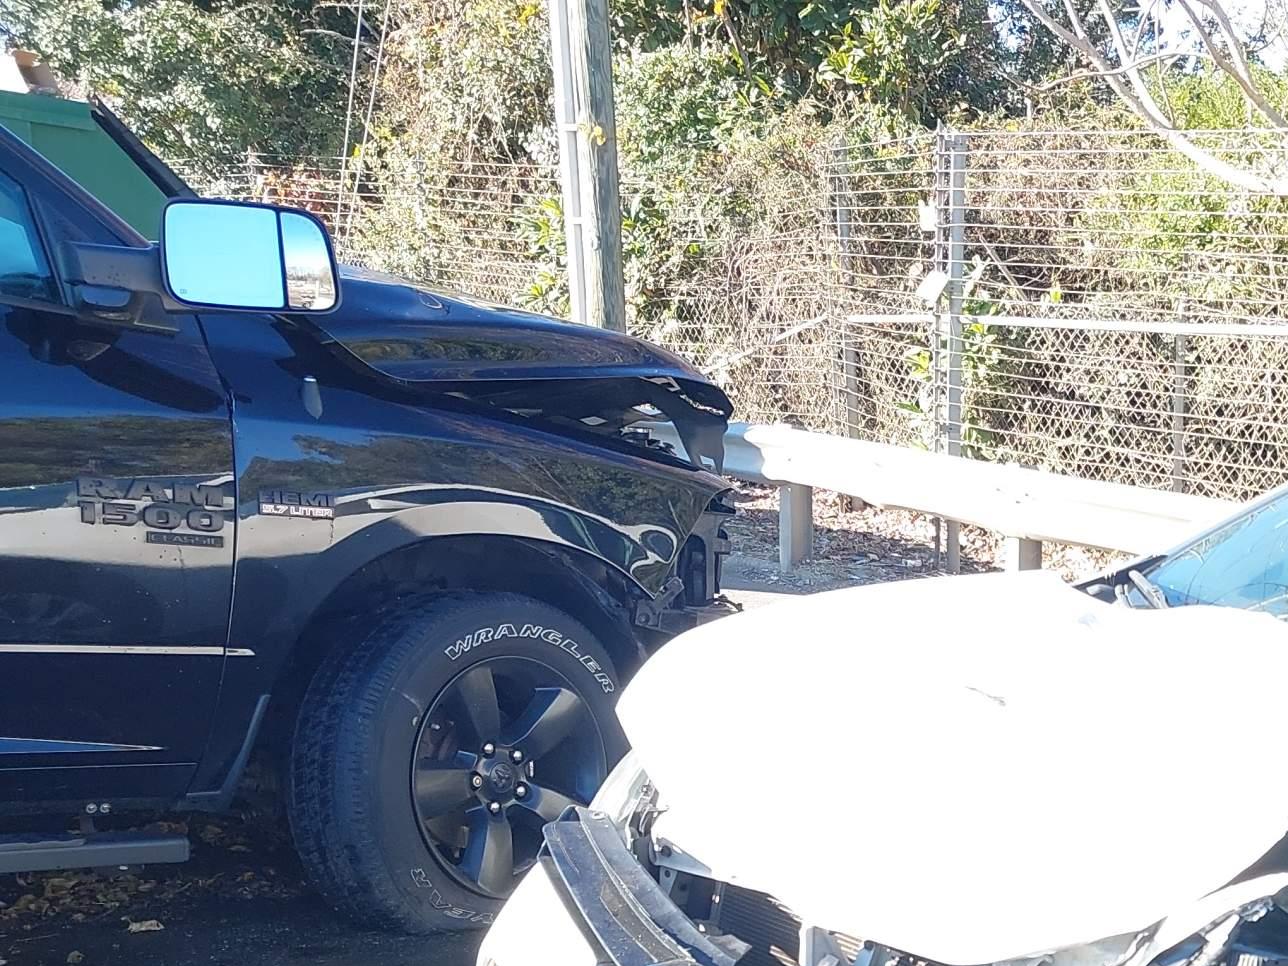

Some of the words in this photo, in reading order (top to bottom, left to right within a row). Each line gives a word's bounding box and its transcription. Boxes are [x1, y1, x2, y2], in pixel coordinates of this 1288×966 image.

[77, 476, 224, 507] RAM
[258, 489, 335, 507] HEMI
[80, 501, 224, 532] 1500
[262, 503, 288, 514] 5.7
[289, 505, 333, 517] LITER
[444, 623, 615, 693] WRANGLER
